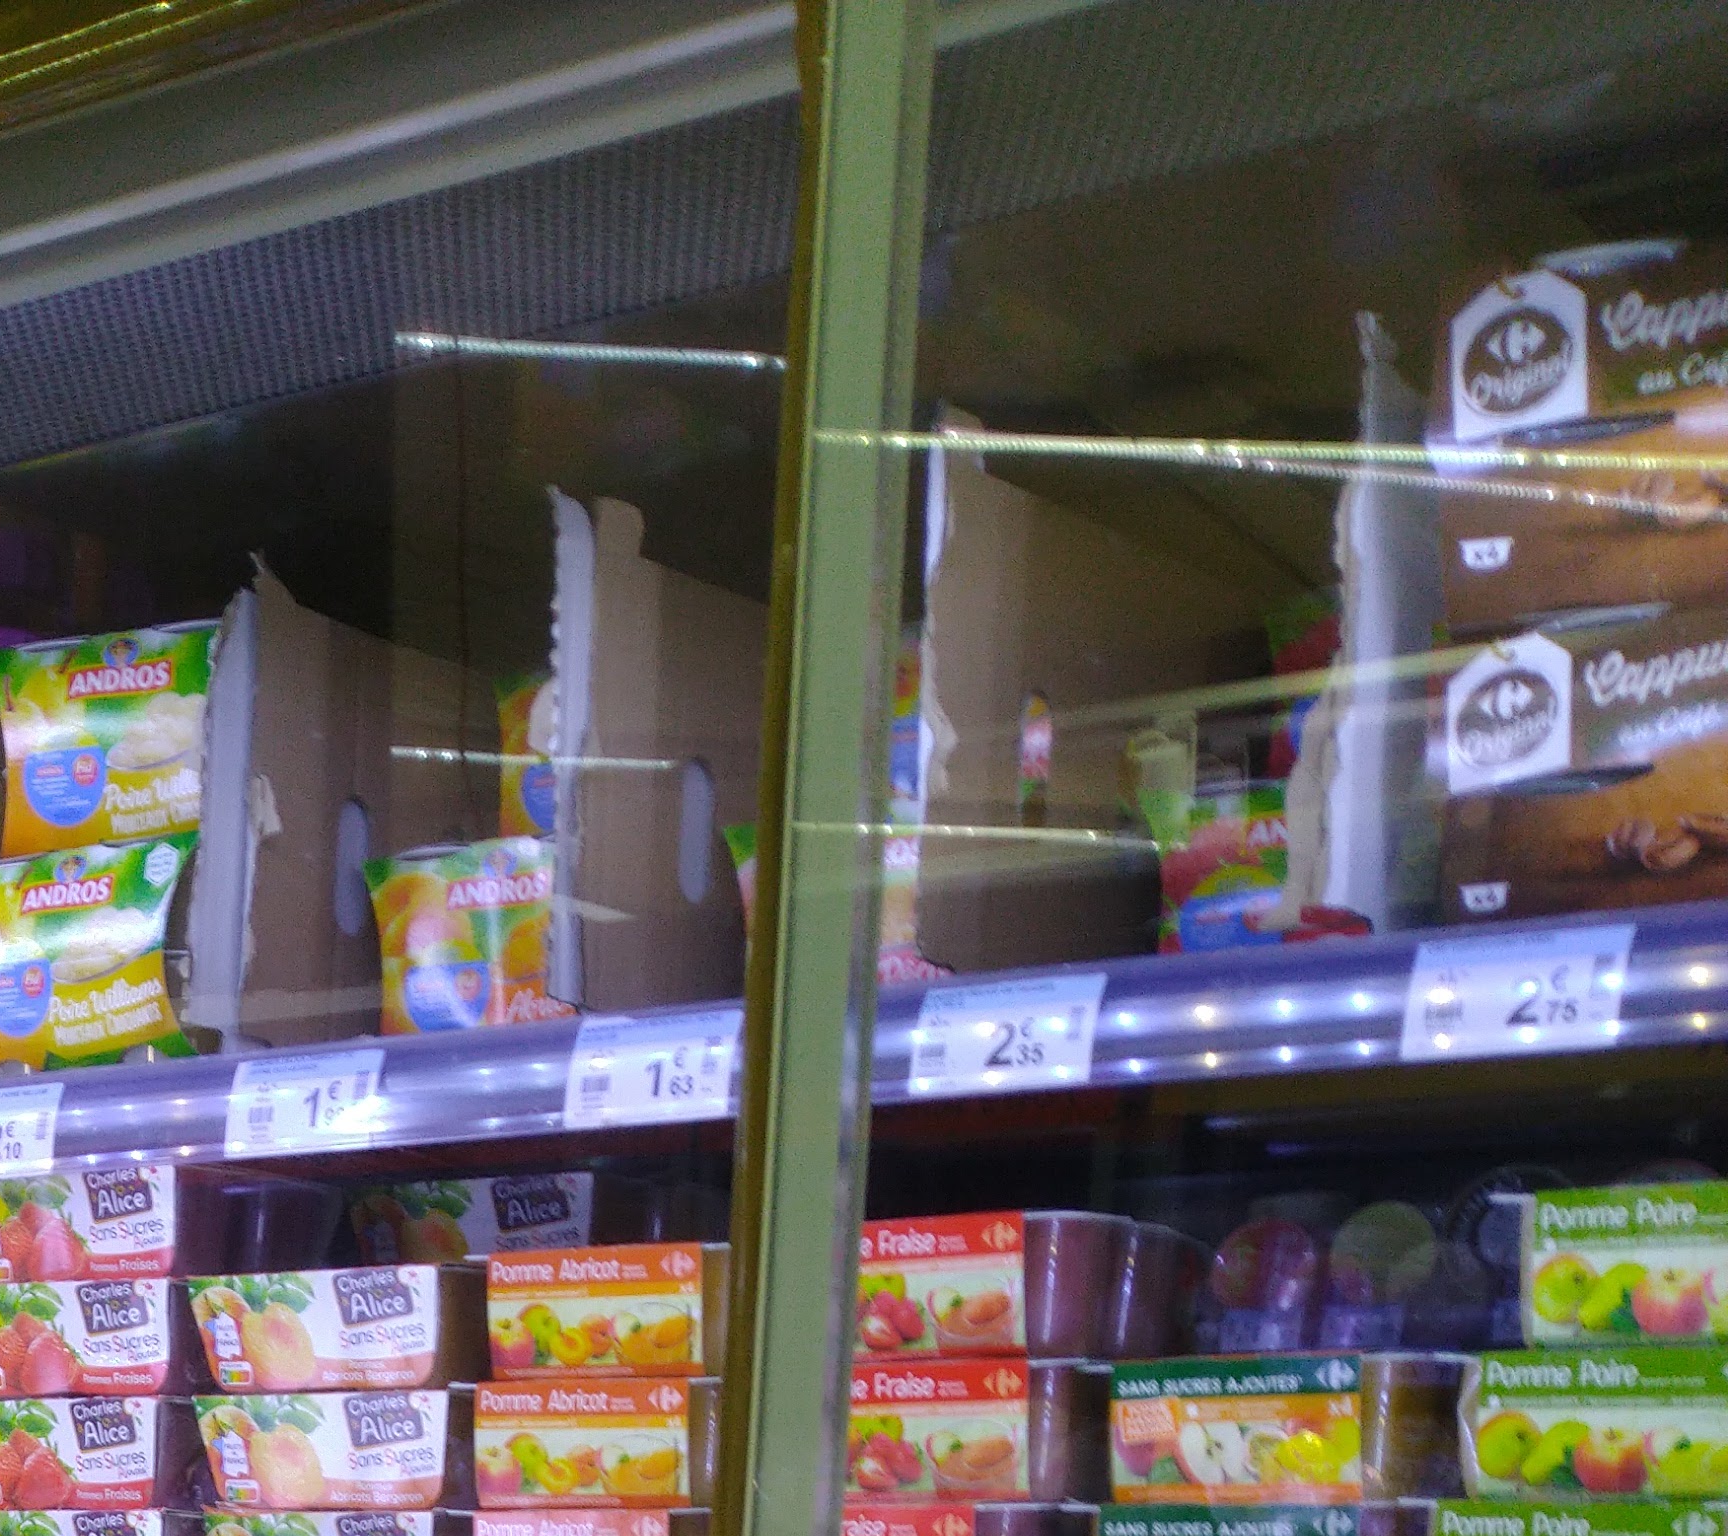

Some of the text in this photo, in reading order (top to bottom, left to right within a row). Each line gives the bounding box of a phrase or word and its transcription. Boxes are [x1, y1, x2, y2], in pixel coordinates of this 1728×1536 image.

[71, 660, 170, 697] ANDROS
[23, 877, 111, 912] ANDROS
[449, 870, 548, 908] ANDROS
[97, 1190, 146, 1217] Alice
[878, 1228, 935, 1256] Fraise
[492, 1262, 554, 1282] Pomme
[560, 1258, 620, 1280] Abricot
[80, 1282, 131, 1300] Charles
[93, 1304, 141, 1329] Alice
[351, 1292, 406, 1321] Alice
[874, 1370, 935, 1400] Fraise
[481, 1389, 607, 1412] Pomme Abricot
[84, 1421, 128, 1447] Alice
